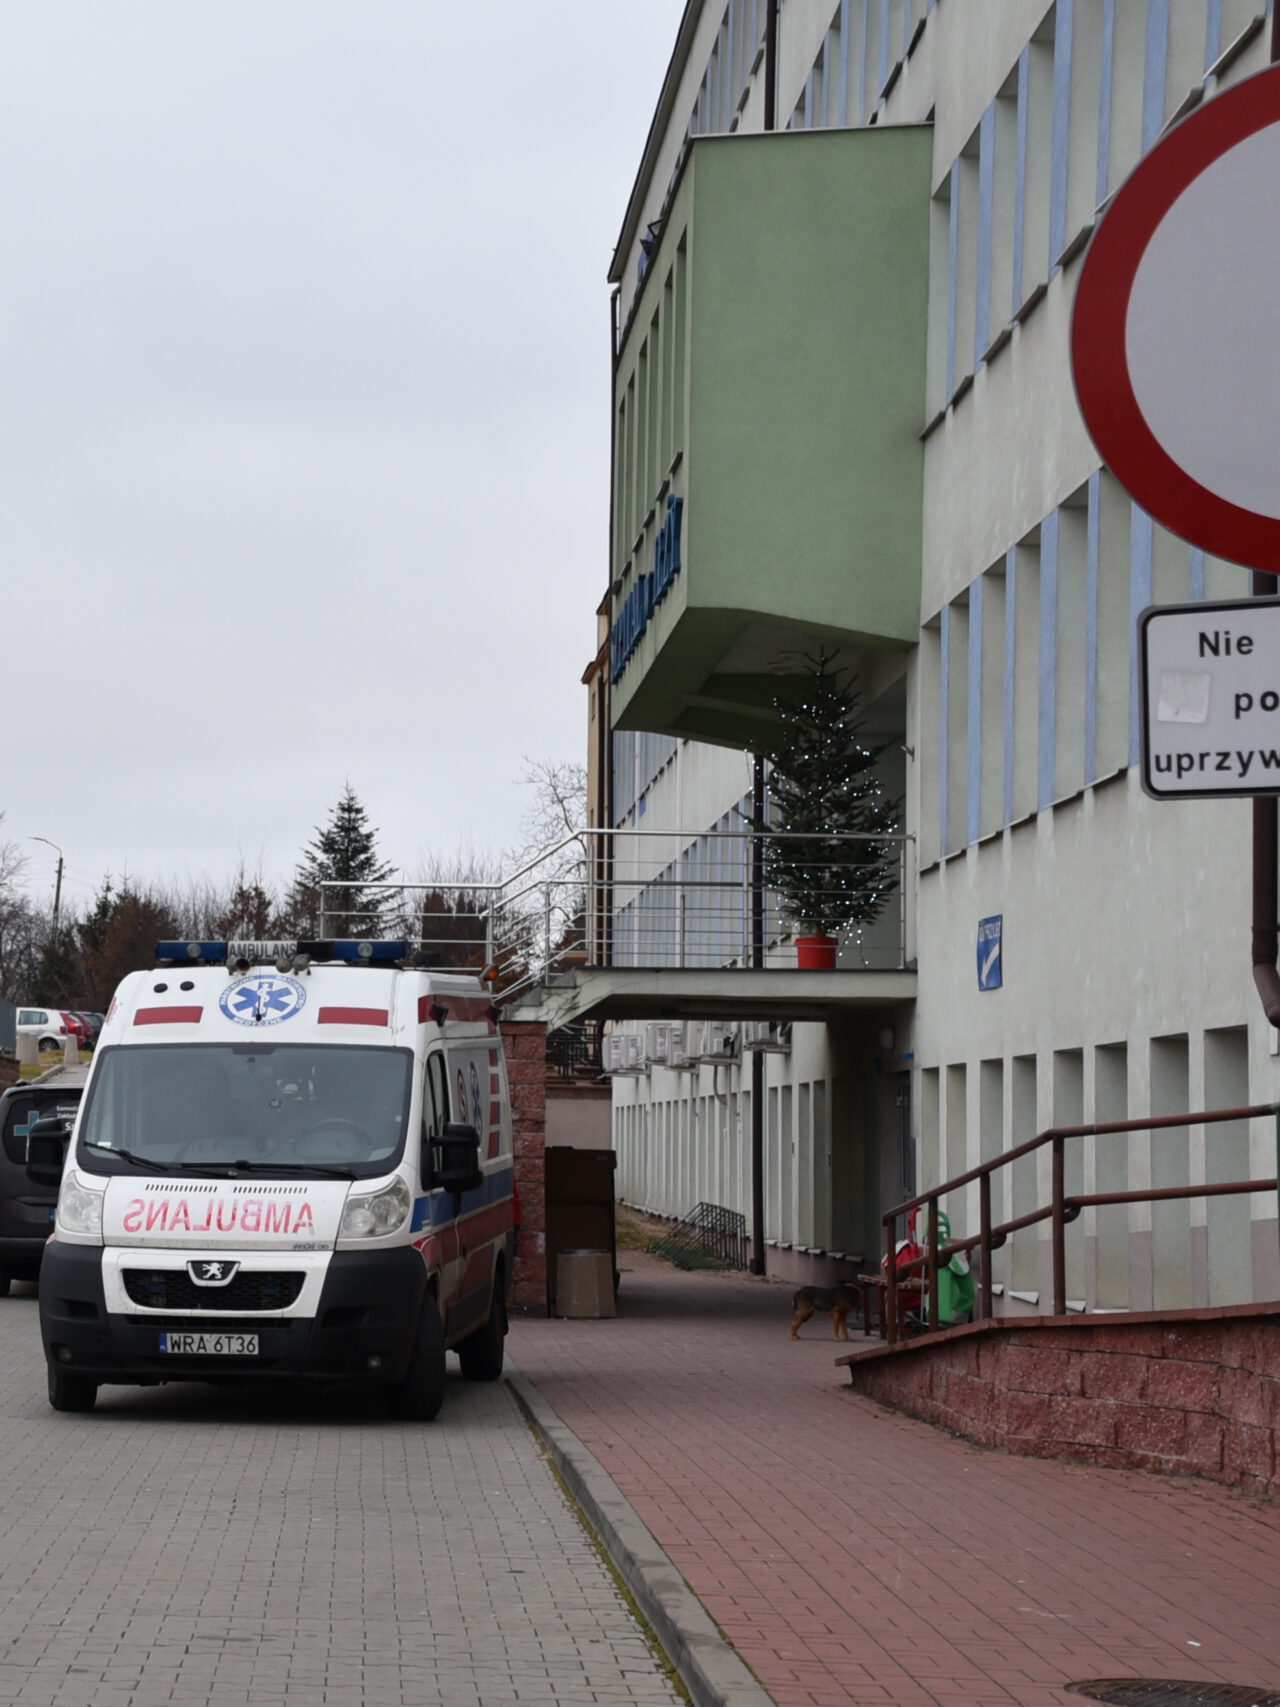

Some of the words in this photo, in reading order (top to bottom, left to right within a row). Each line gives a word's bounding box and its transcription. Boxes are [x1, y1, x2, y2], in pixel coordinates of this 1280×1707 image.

[1198, 630, 1255, 658] Nie
[1234, 690, 1280, 719] po
[1154, 749, 1280, 780] uprzyw
[229, 943, 297, 958] AMBULANS
[170, 1336, 208, 1352] WRA
[213, 1335, 257, 1353] 6T36
